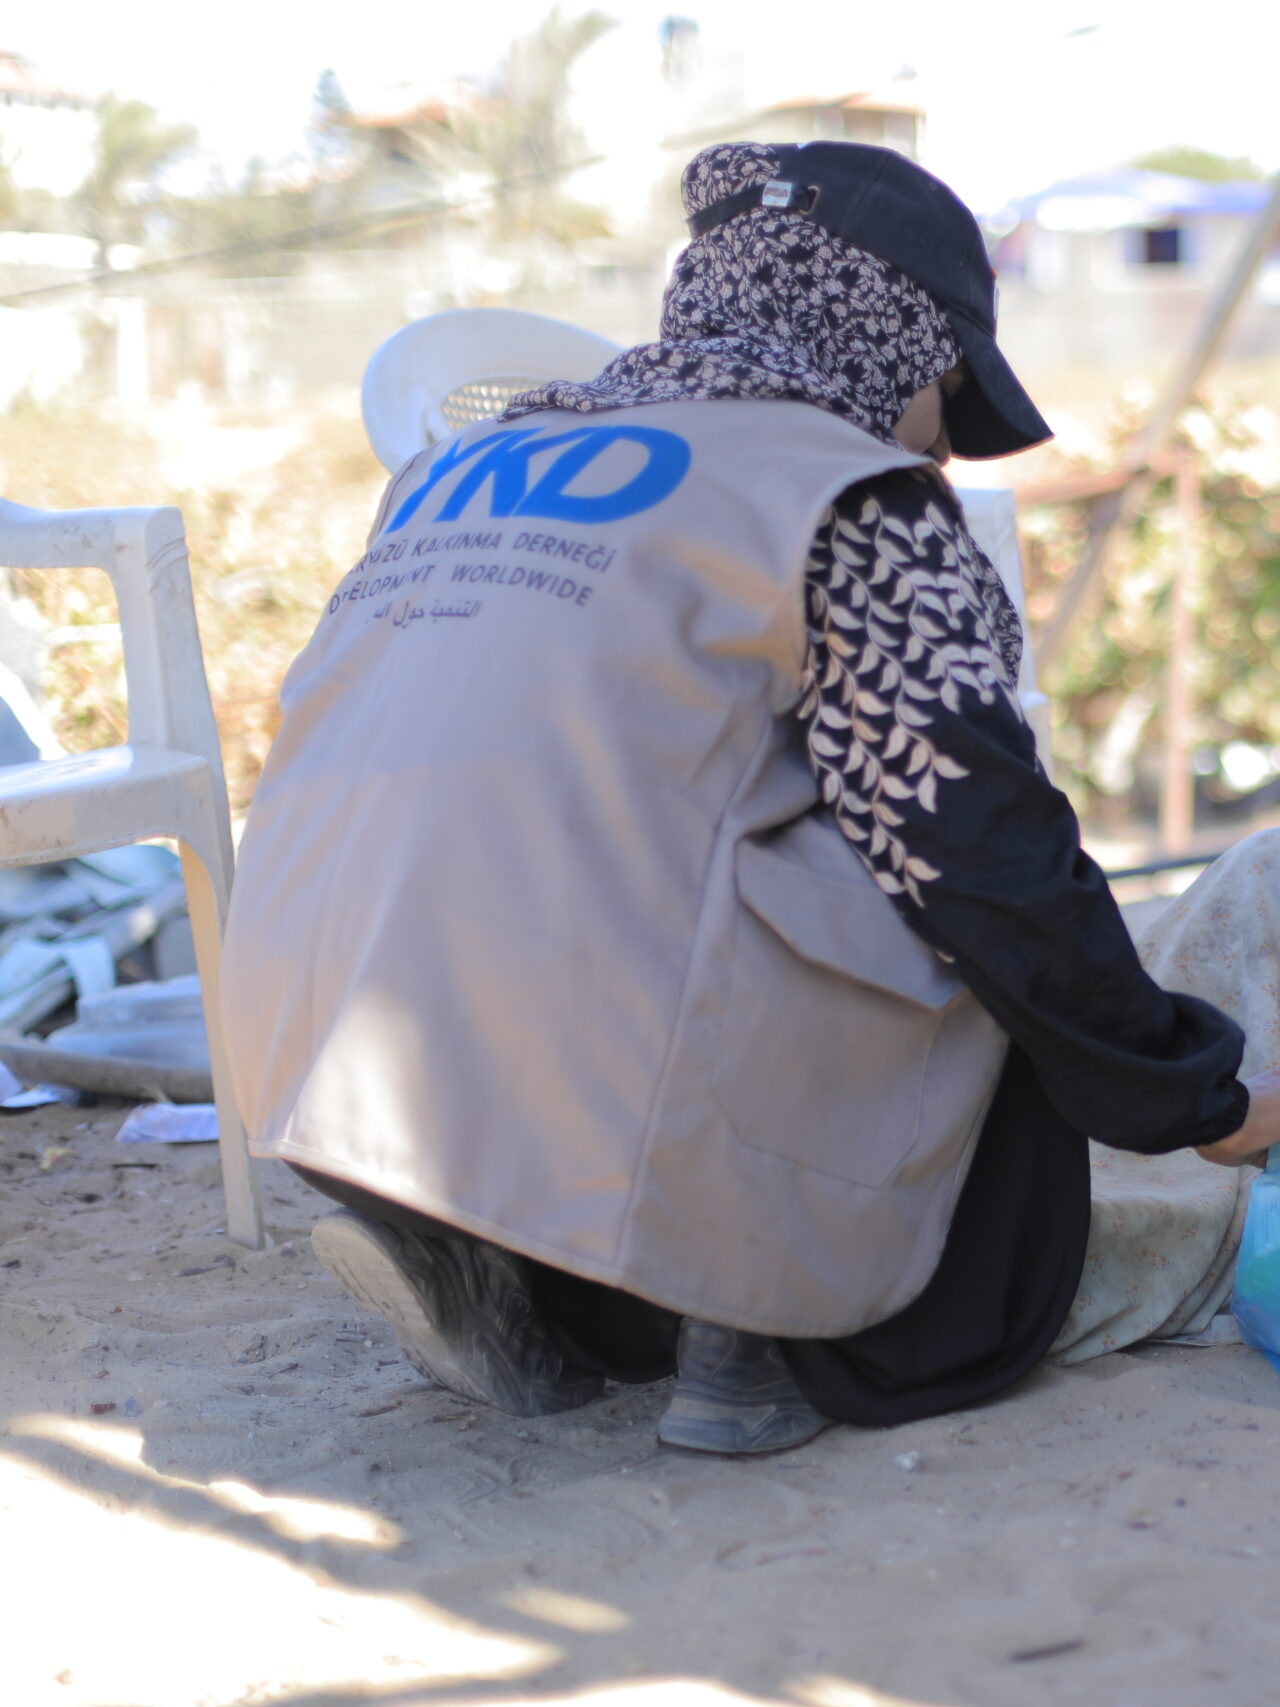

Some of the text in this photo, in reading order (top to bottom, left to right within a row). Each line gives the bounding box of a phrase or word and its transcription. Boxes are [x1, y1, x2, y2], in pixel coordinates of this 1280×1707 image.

[385, 425, 691, 534] YKD
[512, 532, 617, 573] DERNEĞİ
[450, 564, 594, 607] WORLDWIDE
